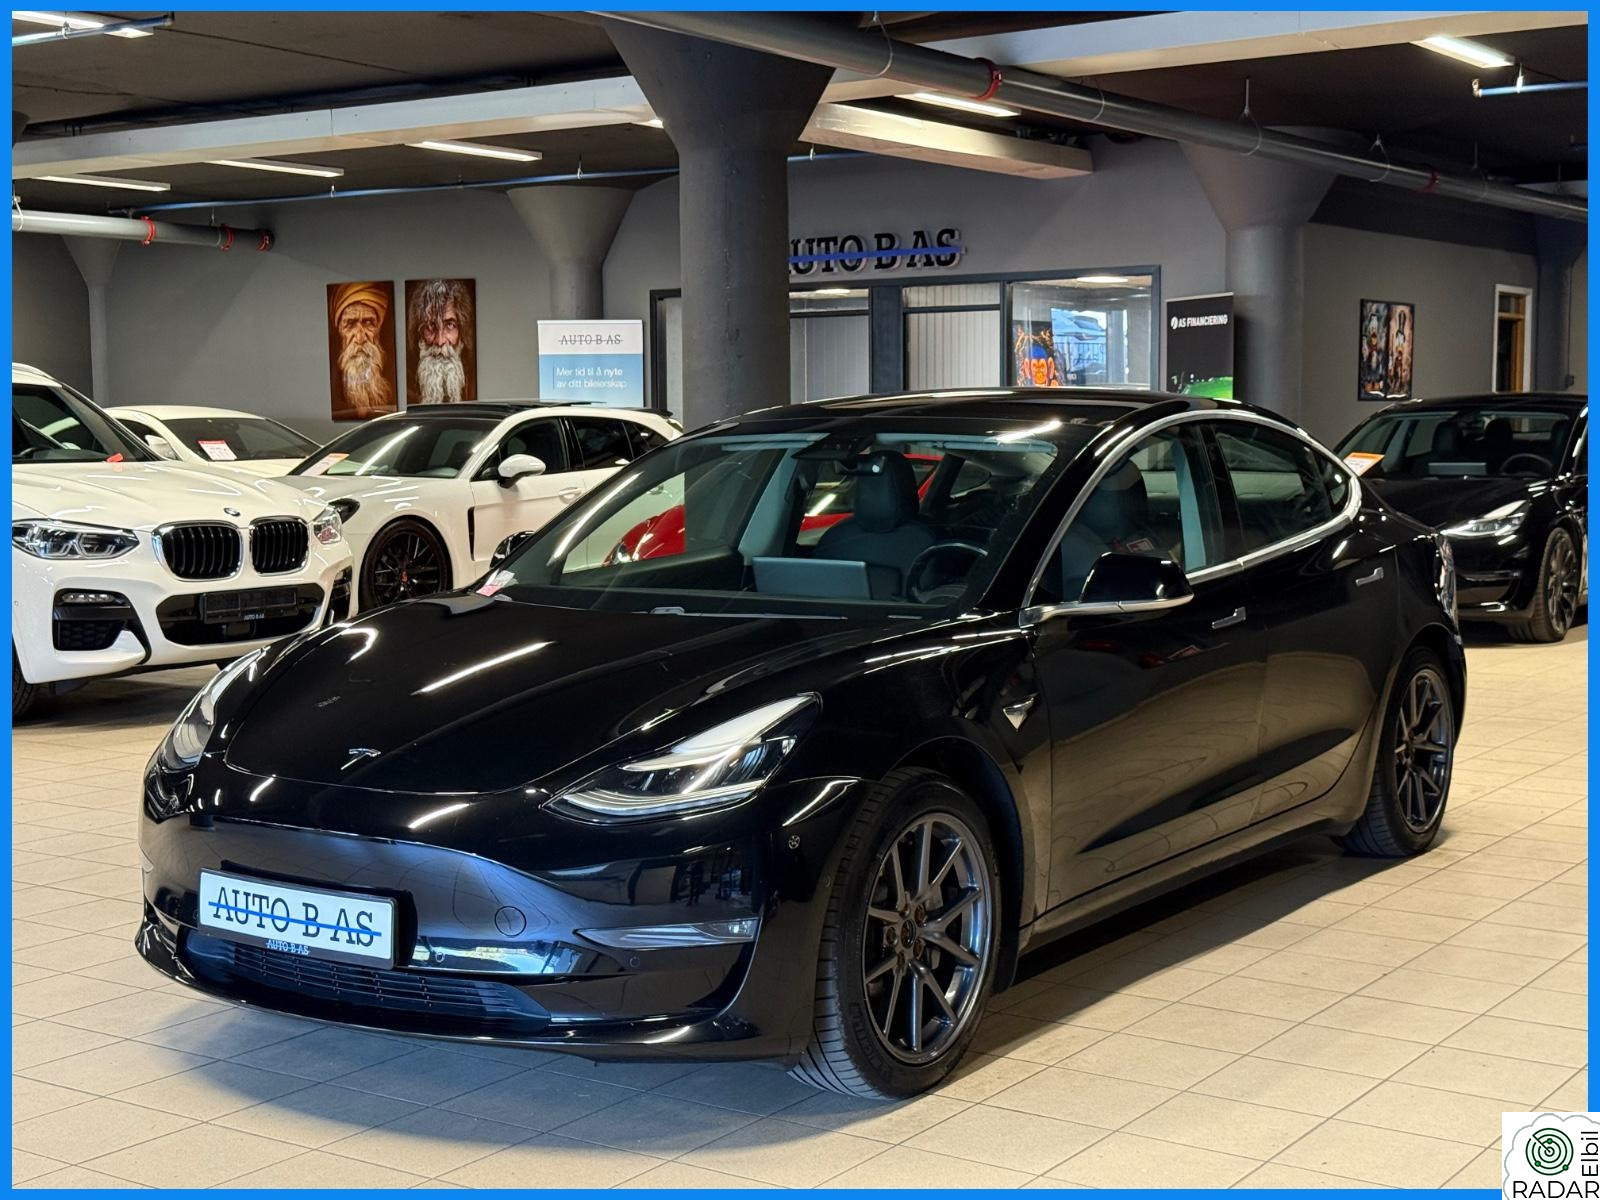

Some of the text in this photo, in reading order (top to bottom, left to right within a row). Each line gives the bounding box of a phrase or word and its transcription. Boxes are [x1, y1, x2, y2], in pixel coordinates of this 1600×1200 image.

[789, 228, 961, 275] UTO B AS
[560, 334, 622, 345] AUTO B AS
[556, 367, 572, 377] Mer
[575, 367, 586, 376] tid
[603, 367, 623, 378] nyte
[212, 886, 375, 947] AUTO B AS
[266, 939, 310, 956] AUTO B AS
